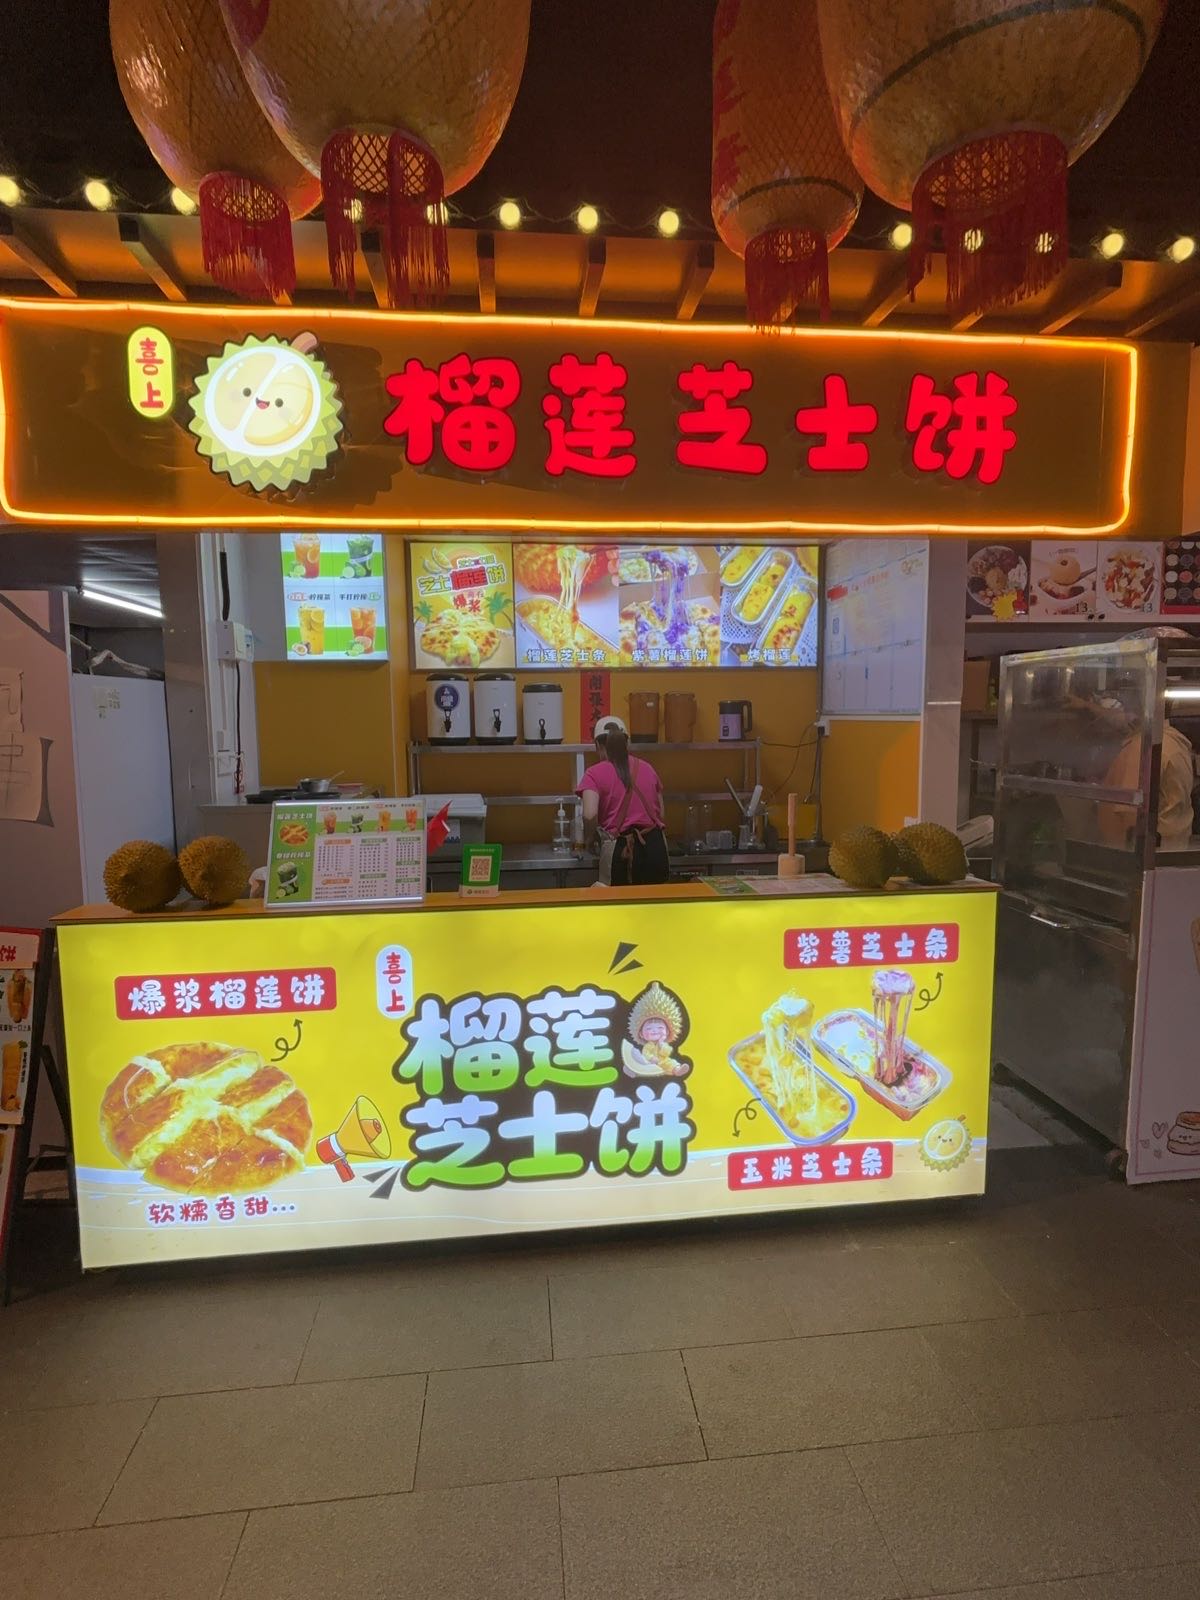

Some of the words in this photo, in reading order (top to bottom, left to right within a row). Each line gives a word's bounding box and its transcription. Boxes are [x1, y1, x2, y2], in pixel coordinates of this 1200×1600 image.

[135, 337, 164, 409] 喜上
[384, 352, 1018, 485] 榴莲芝士饼
[528, 648, 606, 662] 榴莲芝士条
[631, 648, 708, 662] 紫薯榴莲饼
[748, 648, 791, 661] 烤榴莲
[797, 927, 949, 965] 紫薯芝士条
[128, 973, 326, 1016] 爆浆榴莲饼
[382, 951, 406, 1013] 喜上
[398, 988, 619, 1096] 榴莲
[405, 1082, 692, 1187] 芝士饼
[741, 1146, 884, 1185] 玉米芝士条
